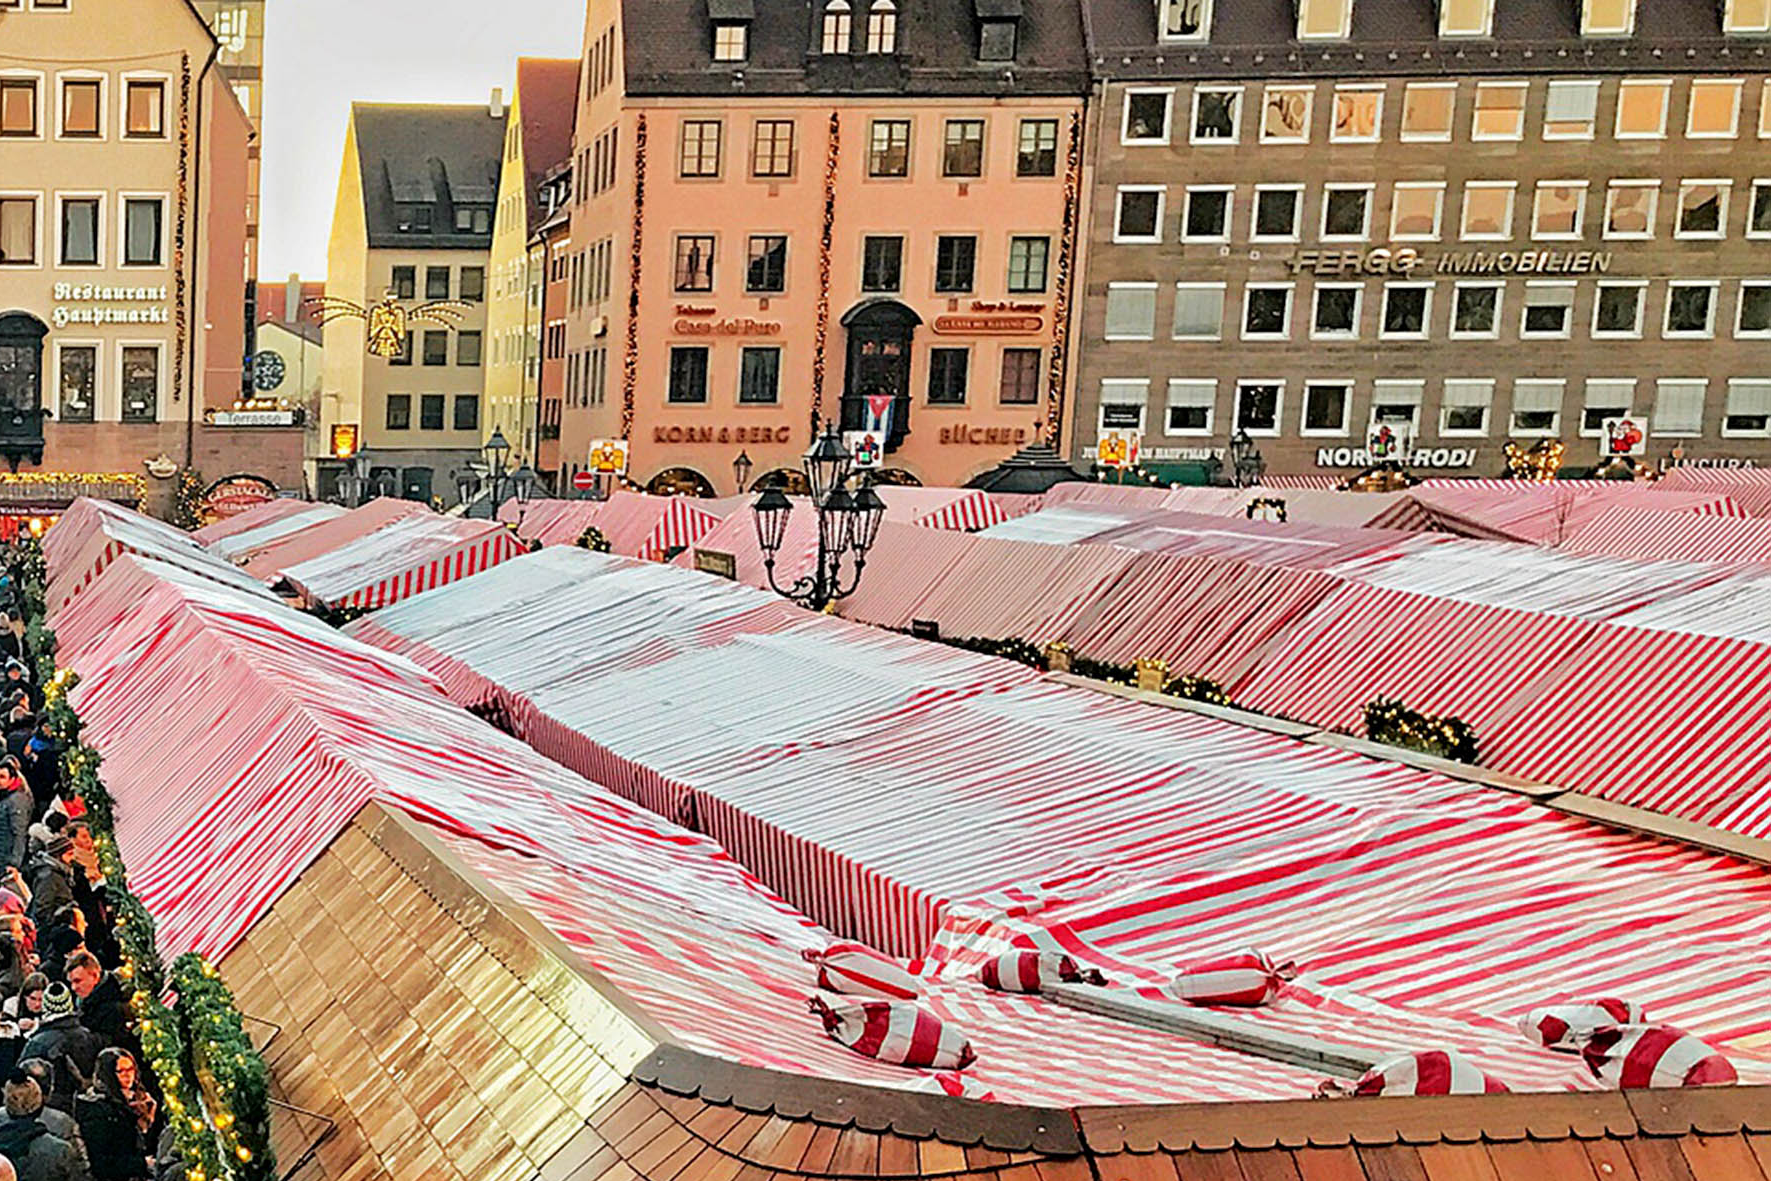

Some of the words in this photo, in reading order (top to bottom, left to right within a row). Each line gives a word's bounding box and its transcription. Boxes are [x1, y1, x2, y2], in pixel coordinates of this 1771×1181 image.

[1437, 251, 1612, 273] IMMOBILIEN
[54, 282, 167, 300] Restaurant
[52, 306, 169, 327] Hauptmarkt
[653, 426, 713, 443] KORN
[735, 426, 790, 443] BERG
